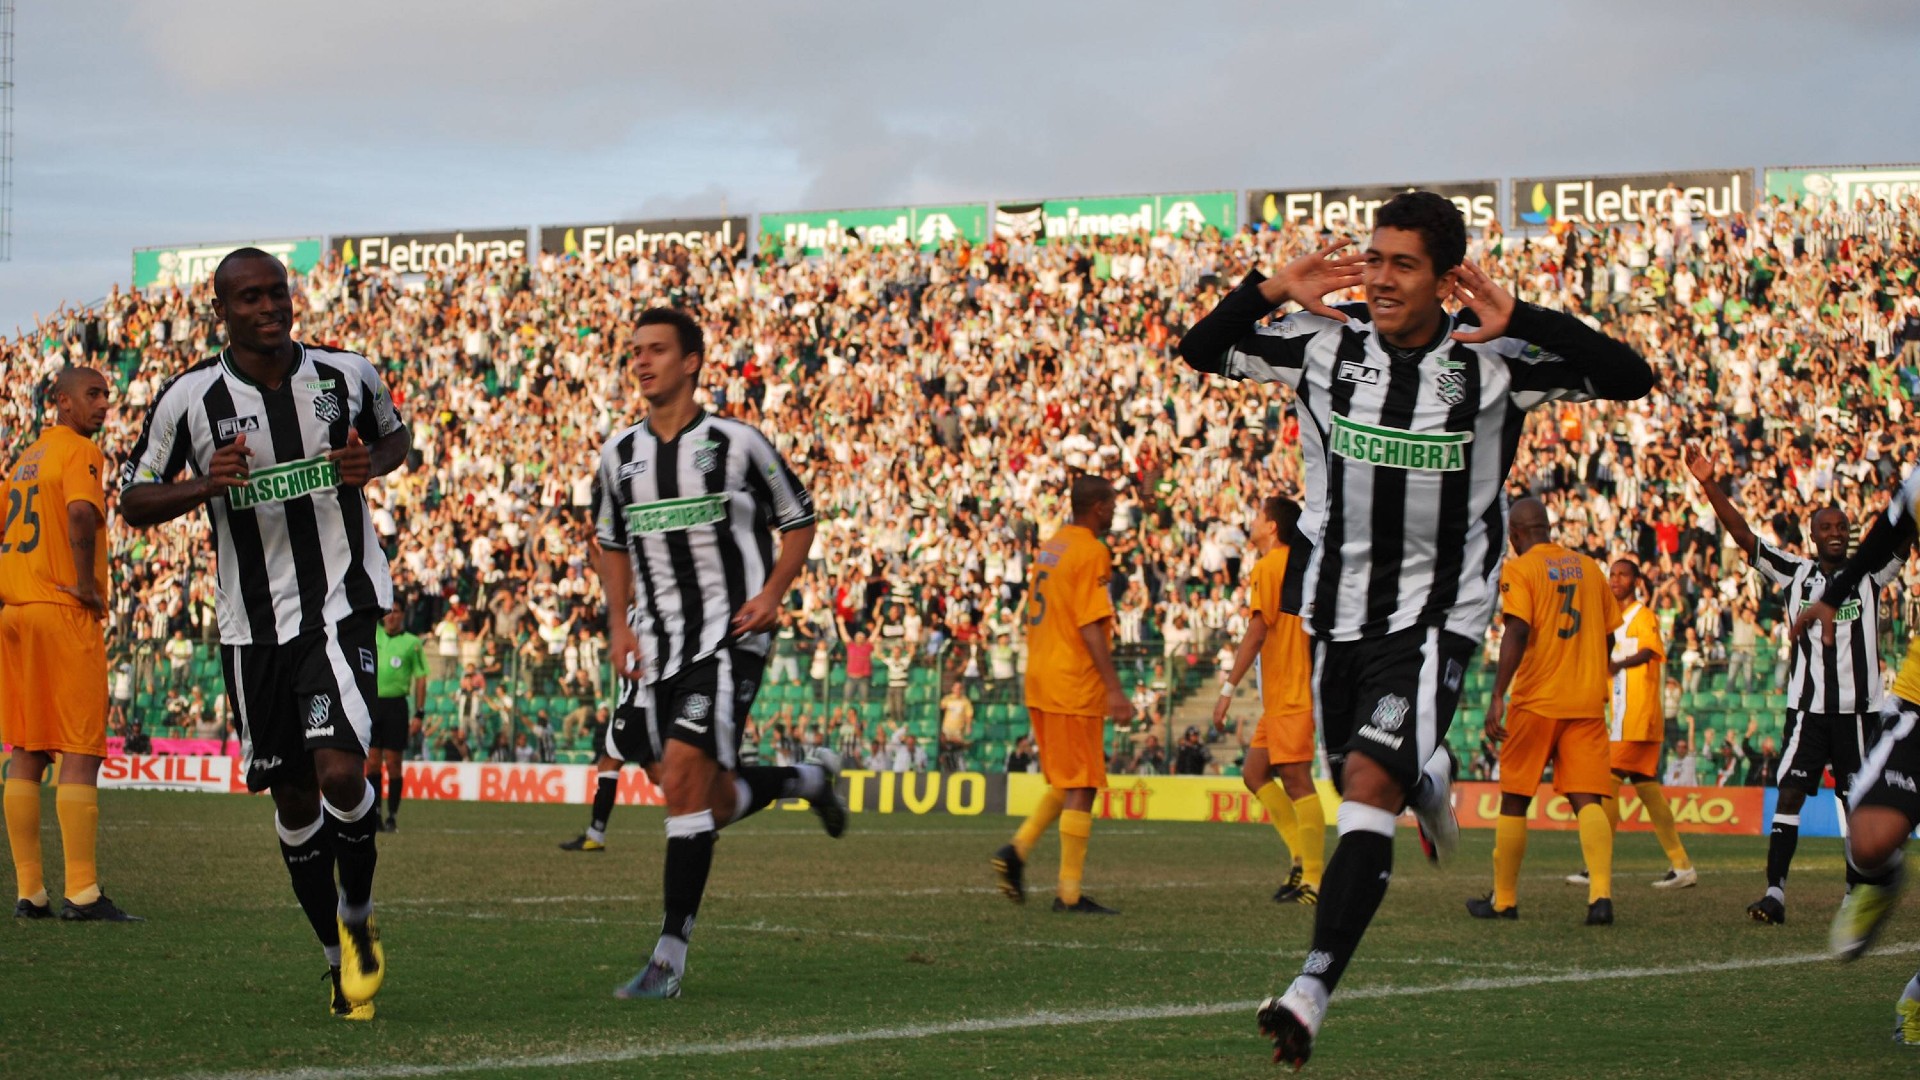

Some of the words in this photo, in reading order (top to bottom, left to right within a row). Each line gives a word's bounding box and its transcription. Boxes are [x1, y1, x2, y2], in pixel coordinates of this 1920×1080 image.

[1555, 174, 1742, 223] Eletrosul
[1043, 204, 1152, 239] nimed
[359, 233, 525, 273] Eletrobras
[1341, 363, 1379, 384] FILA
[219, 416, 258, 437] FILA
[1331, 415, 1465, 470] TASCHIBRA
[229, 456, 341, 508] TASCHIBR
[1, 484, 40, 553] 25
[1030, 570, 1048, 625] 5
[1557, 583, 1582, 640] 3
[102, 756, 221, 783] SKILL
[478, 767, 567, 804] BMG
